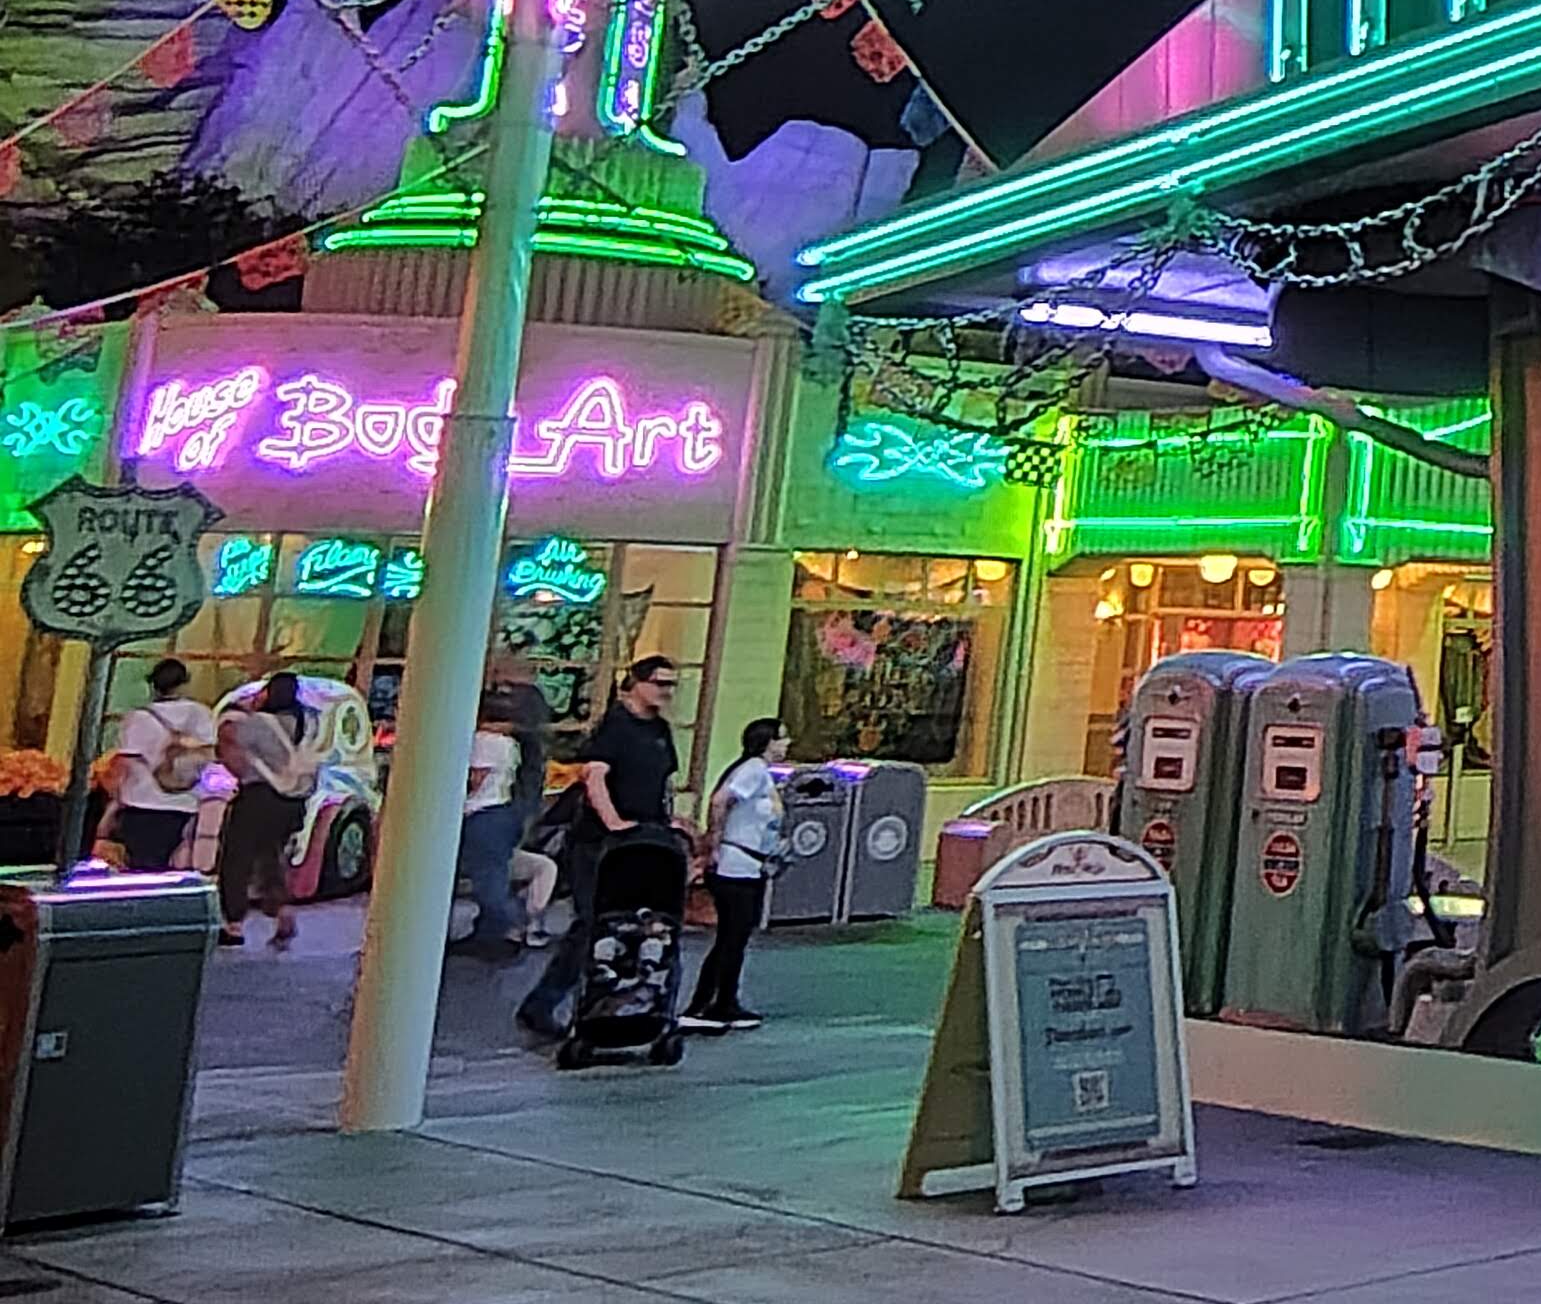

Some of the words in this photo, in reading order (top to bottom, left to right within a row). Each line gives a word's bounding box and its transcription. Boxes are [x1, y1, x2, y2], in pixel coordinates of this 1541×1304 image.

[137, 364, 264, 456] House
[177, 411, 238, 472] of
[256, 373, 460, 476] Bod
[506, 376, 724, 476] Art
[77, 504, 183, 544] ROUTE
[52, 543, 178, 618] 66
